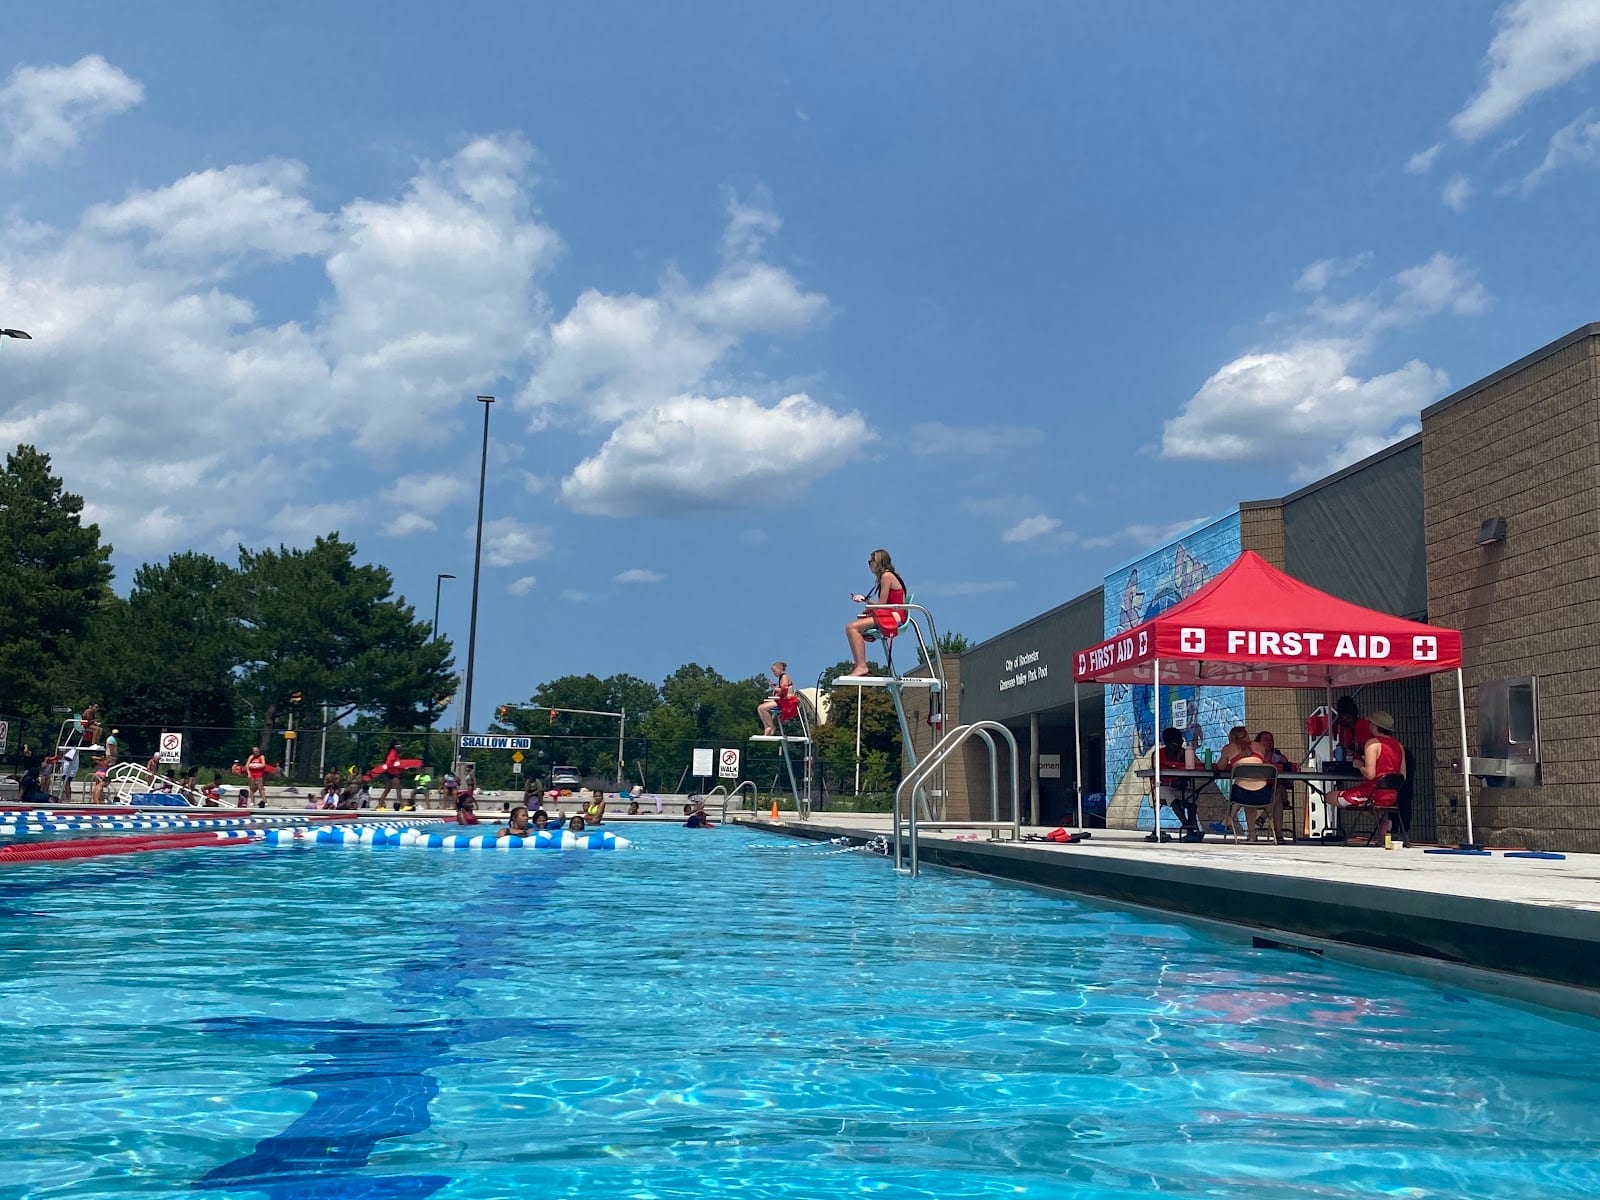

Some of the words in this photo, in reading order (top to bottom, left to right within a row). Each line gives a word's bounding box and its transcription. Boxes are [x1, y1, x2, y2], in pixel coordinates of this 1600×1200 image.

[1089, 643, 1115, 672] FIRST
[1117, 637, 1134, 663] AID
[1227, 630, 1325, 656] FIRST
[1333, 634, 1391, 659] AID
[462, 736, 508, 748] SHALLOW
[510, 738, 529, 748] END
